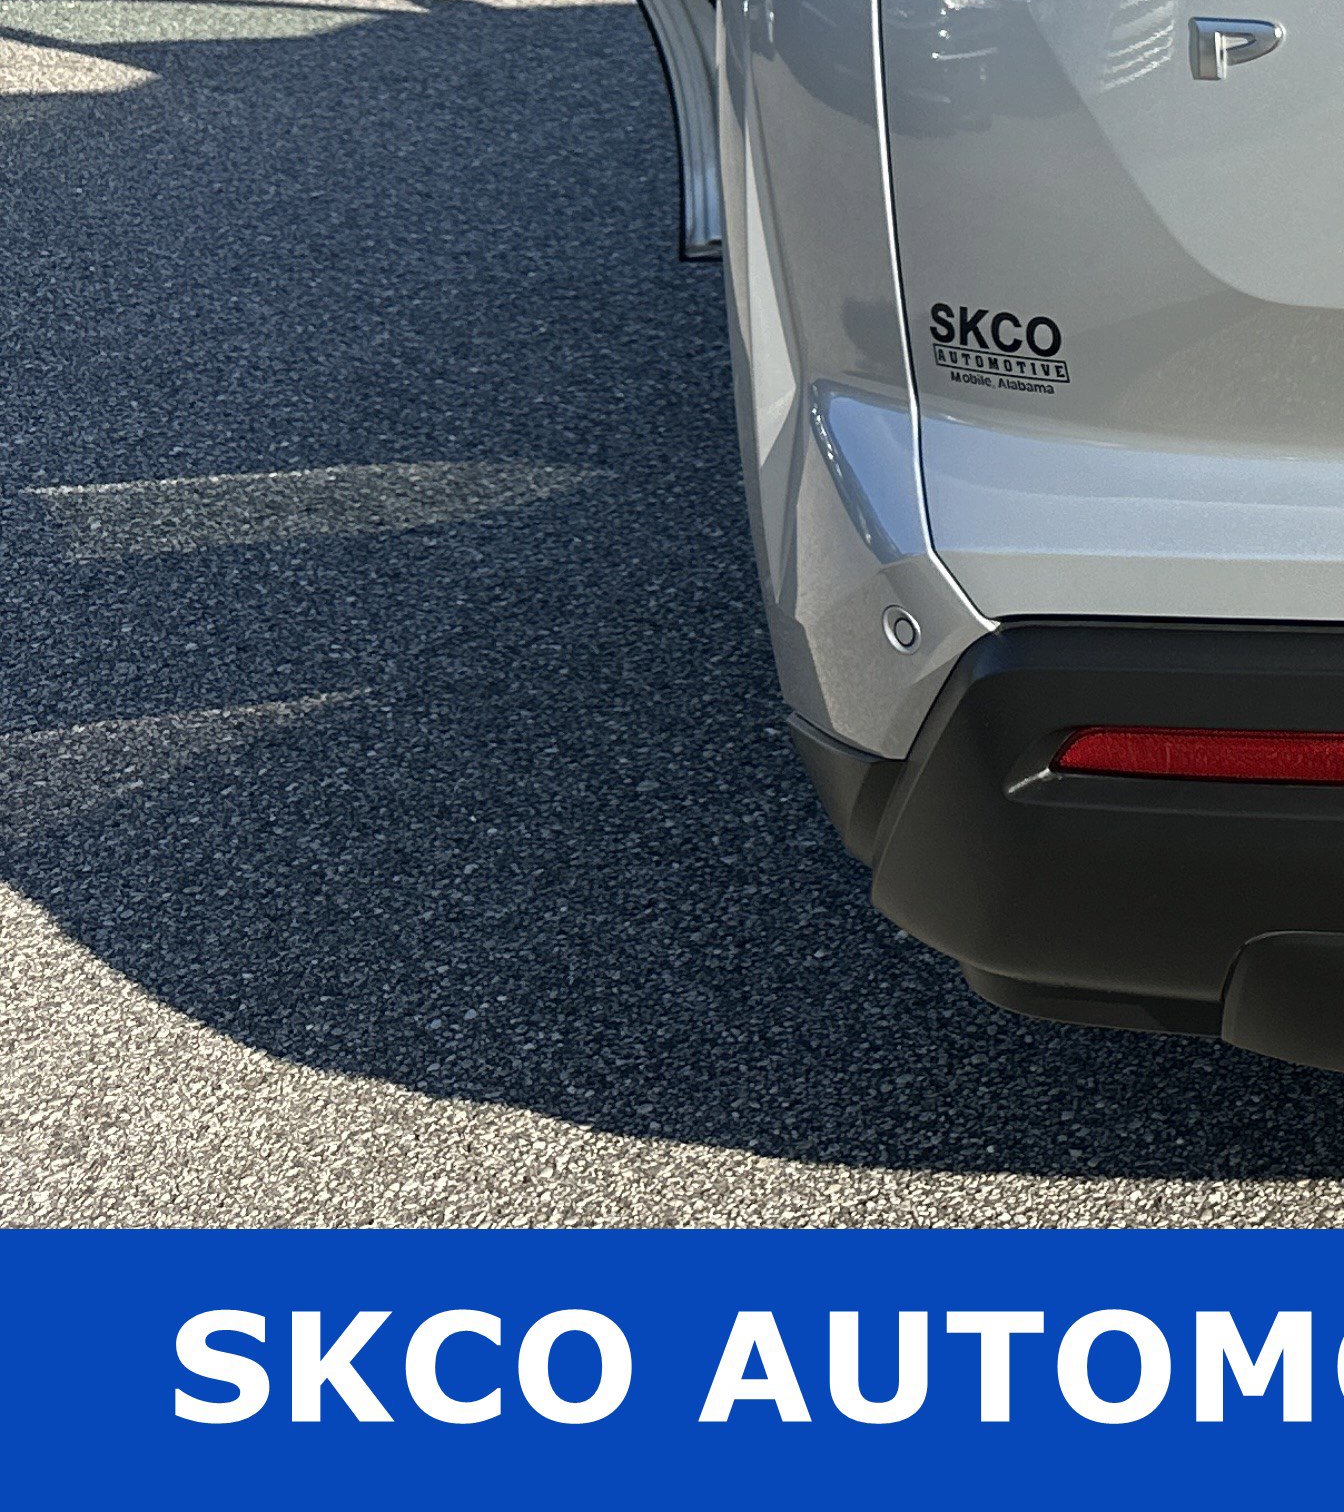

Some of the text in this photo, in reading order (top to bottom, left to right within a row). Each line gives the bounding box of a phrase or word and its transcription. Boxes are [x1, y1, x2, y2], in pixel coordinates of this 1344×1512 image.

[930, 303, 1061, 357] SKCO
[938, 348, 1065, 378] AUTOMOTIVE
[998, 378, 1055, 394] Alabama
